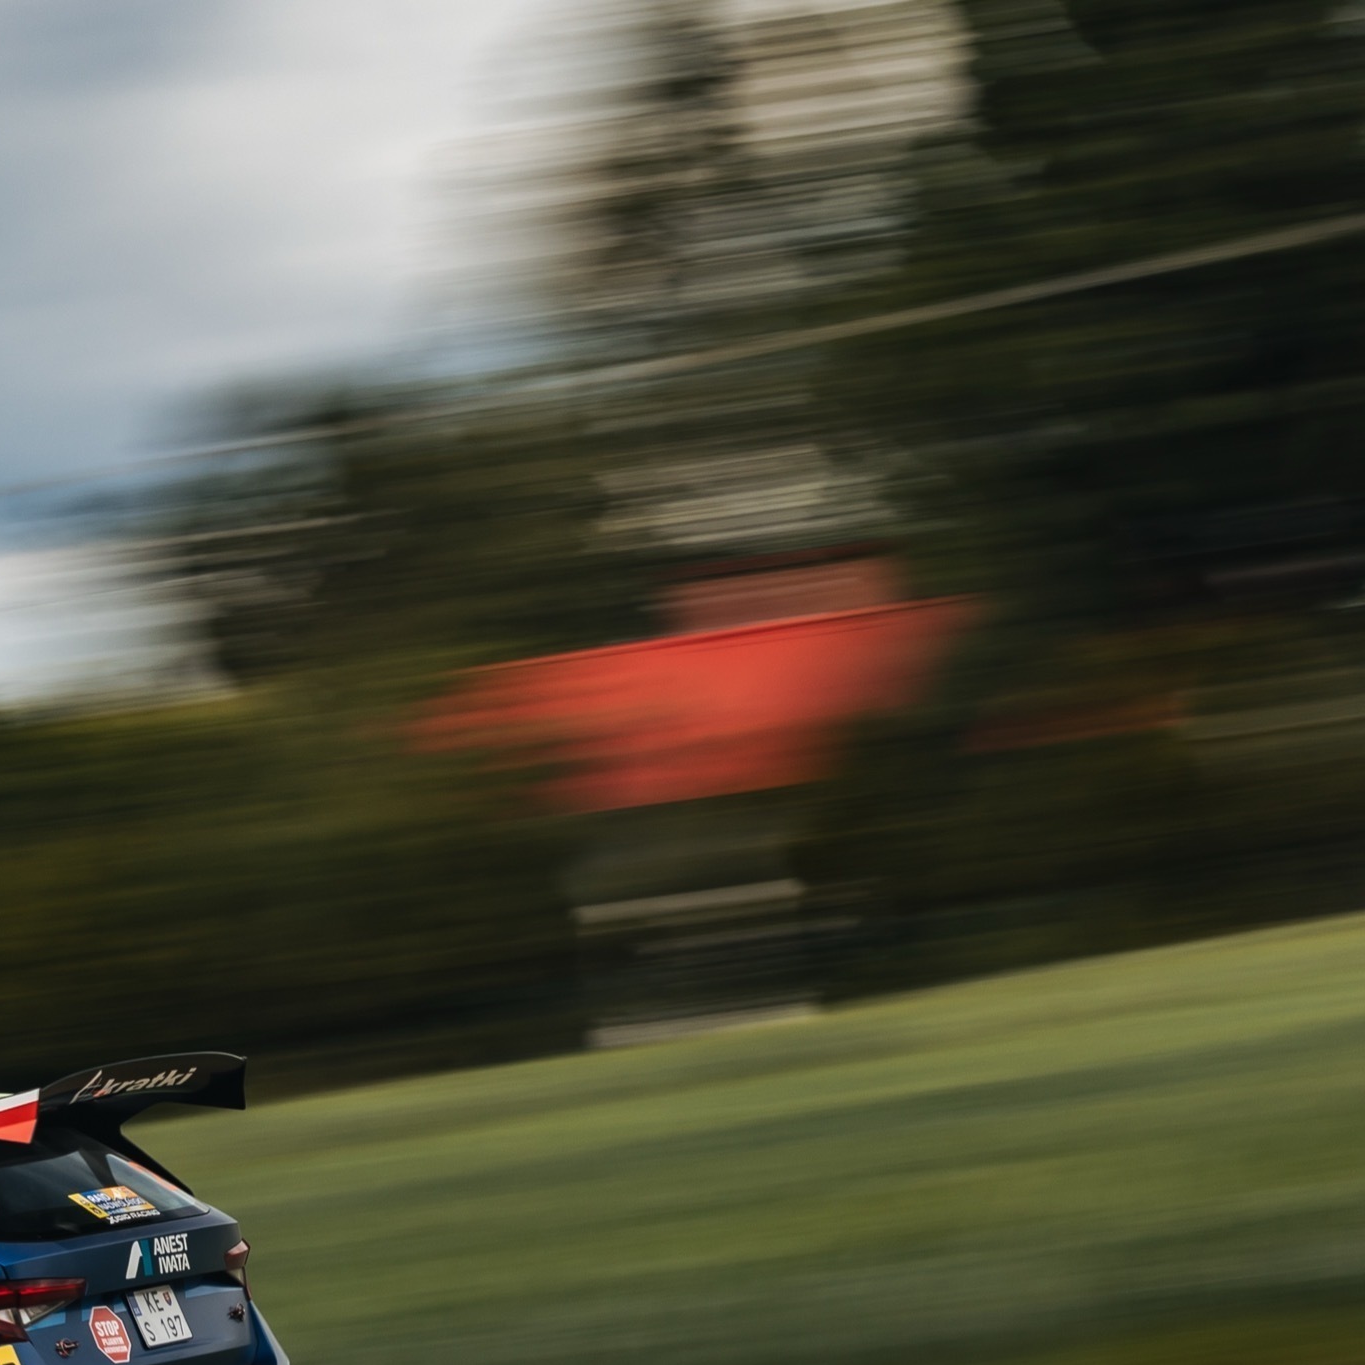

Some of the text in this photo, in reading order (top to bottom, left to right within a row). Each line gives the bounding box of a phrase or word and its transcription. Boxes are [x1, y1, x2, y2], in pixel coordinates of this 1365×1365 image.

[101, 1067, 197, 1095] kratki
[154, 1233, 188, 1256] ANEST
[158, 1253, 191, 1275] IWATA
[142, 1291, 164, 1313] KE
[94, 1321, 120, 1337] STOP
[144, 1315, 185, 1342] S 197
